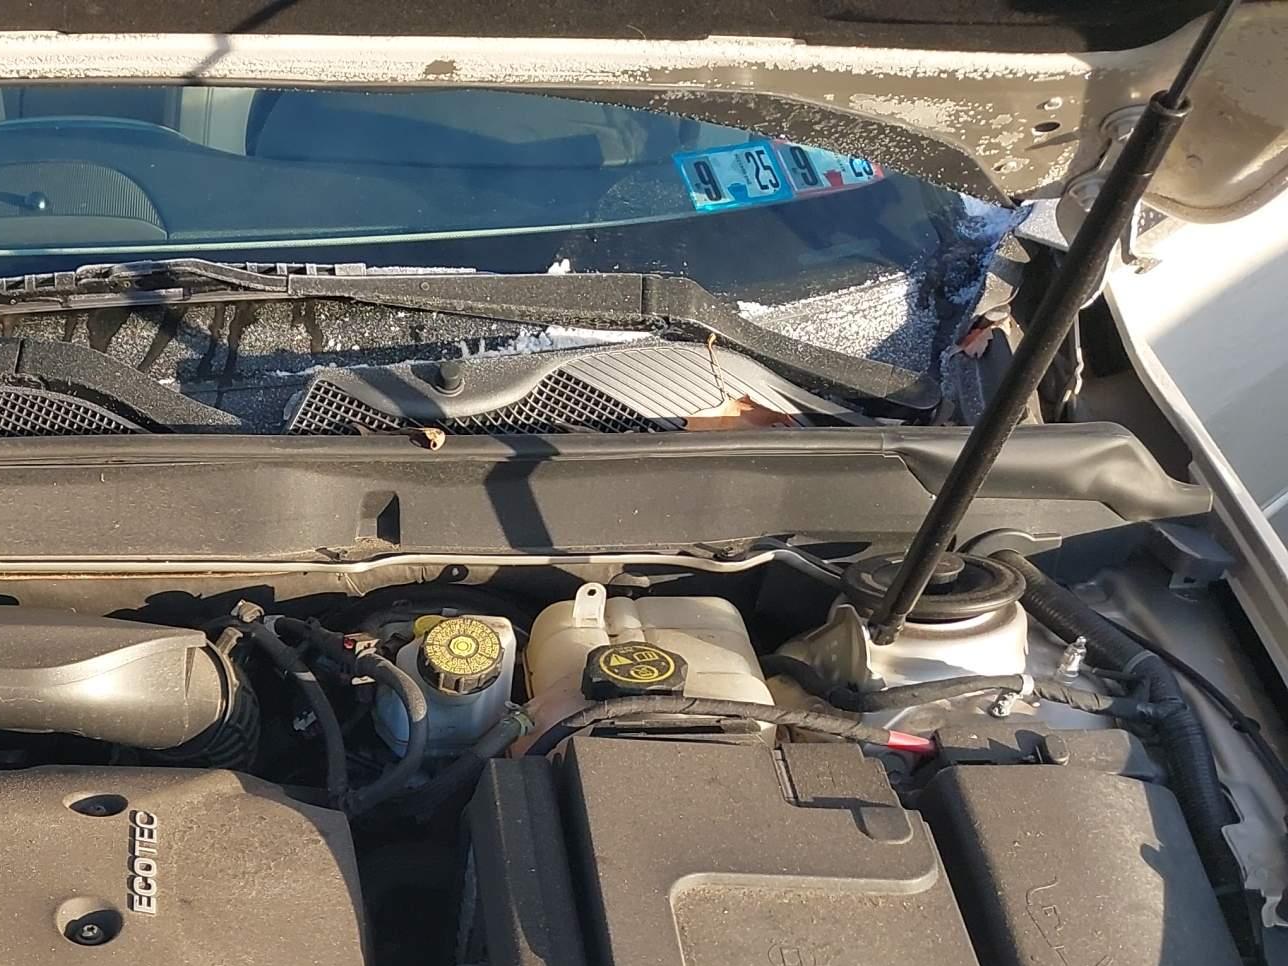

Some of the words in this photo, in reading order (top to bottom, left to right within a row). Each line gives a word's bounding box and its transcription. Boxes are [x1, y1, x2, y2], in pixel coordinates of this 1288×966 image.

[694, 161, 722, 202] 9
[745, 150, 780, 190] 25
[788, 146, 818, 186] 9
[132, 811, 159, 916] ECOTEC
